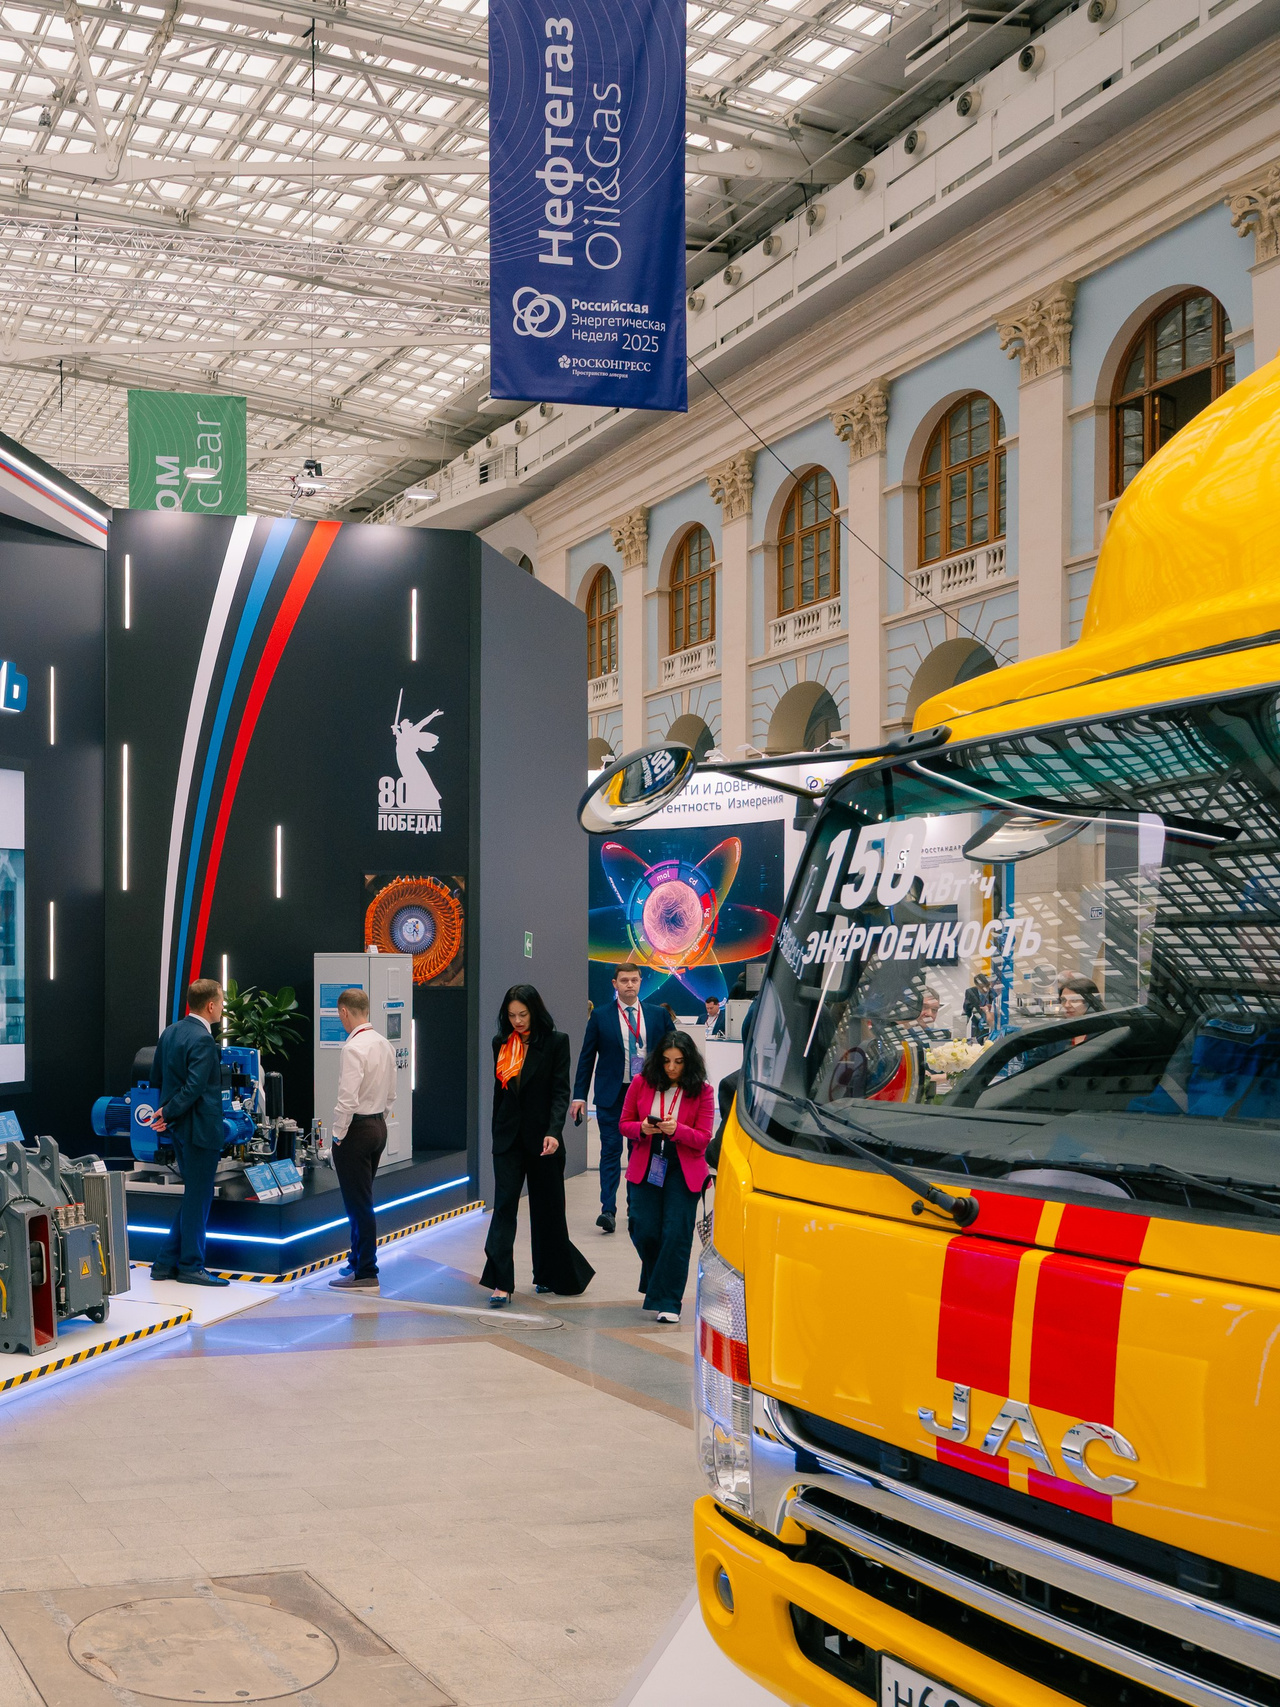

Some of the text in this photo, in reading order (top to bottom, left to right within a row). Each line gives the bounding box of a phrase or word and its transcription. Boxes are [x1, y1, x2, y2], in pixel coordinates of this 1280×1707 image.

[535, 17, 584, 265] Нефтегаз
[584, 83, 622, 270] Oil&Gas
[572, 299, 649, 314] Российская
[572, 314, 666, 332] Энергетическая
[572, 329, 659, 353] Неделя 2025
[572, 357, 651, 372] РОСКОНГРЕСС
[703, 783, 711, 794] И
[727, 794, 784, 810] Измерения
[378, 814, 442, 834] ПОБЕДА!
[921, 845, 964, 854] РОССТАНДАР
[816, 816, 927, 913] 150
[657, 871, 670, 881] mol
[689, 877, 698, 886] cd
[802, 918, 1042, 964] ЭНЕРГОЕМКОСТЬ
[918, 1383, 1139, 1495] JAC
